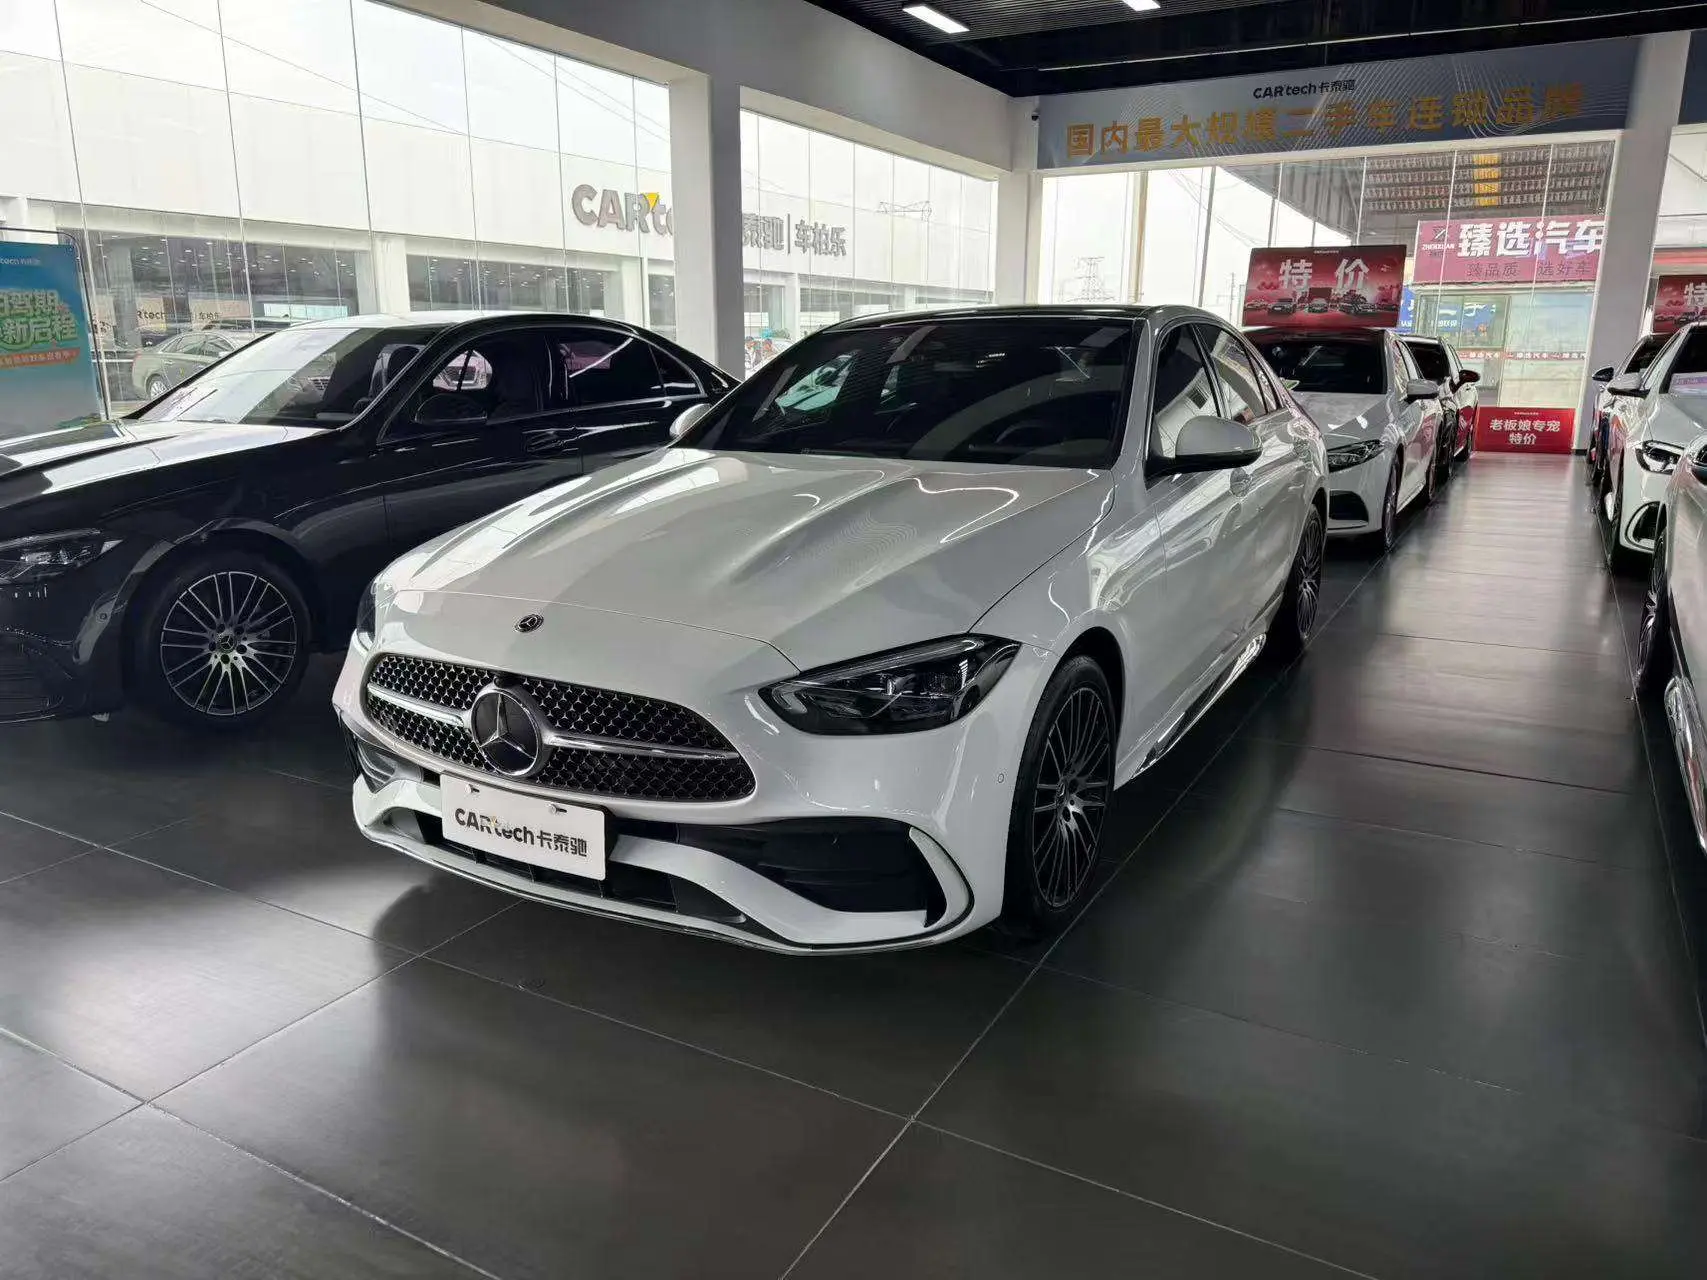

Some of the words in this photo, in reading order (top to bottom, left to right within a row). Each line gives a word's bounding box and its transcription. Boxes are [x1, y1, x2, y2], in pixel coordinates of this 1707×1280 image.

[572, 183, 673, 236] CARt
[1457, 219, 1605, 259] 臻选汽车
[1279, 258, 1369, 291] 特价
[0, 315, 78, 344] 新启程
[1490, 418, 1561, 432] 老板娘专宠
[1508, 432, 1537, 445] 特价
